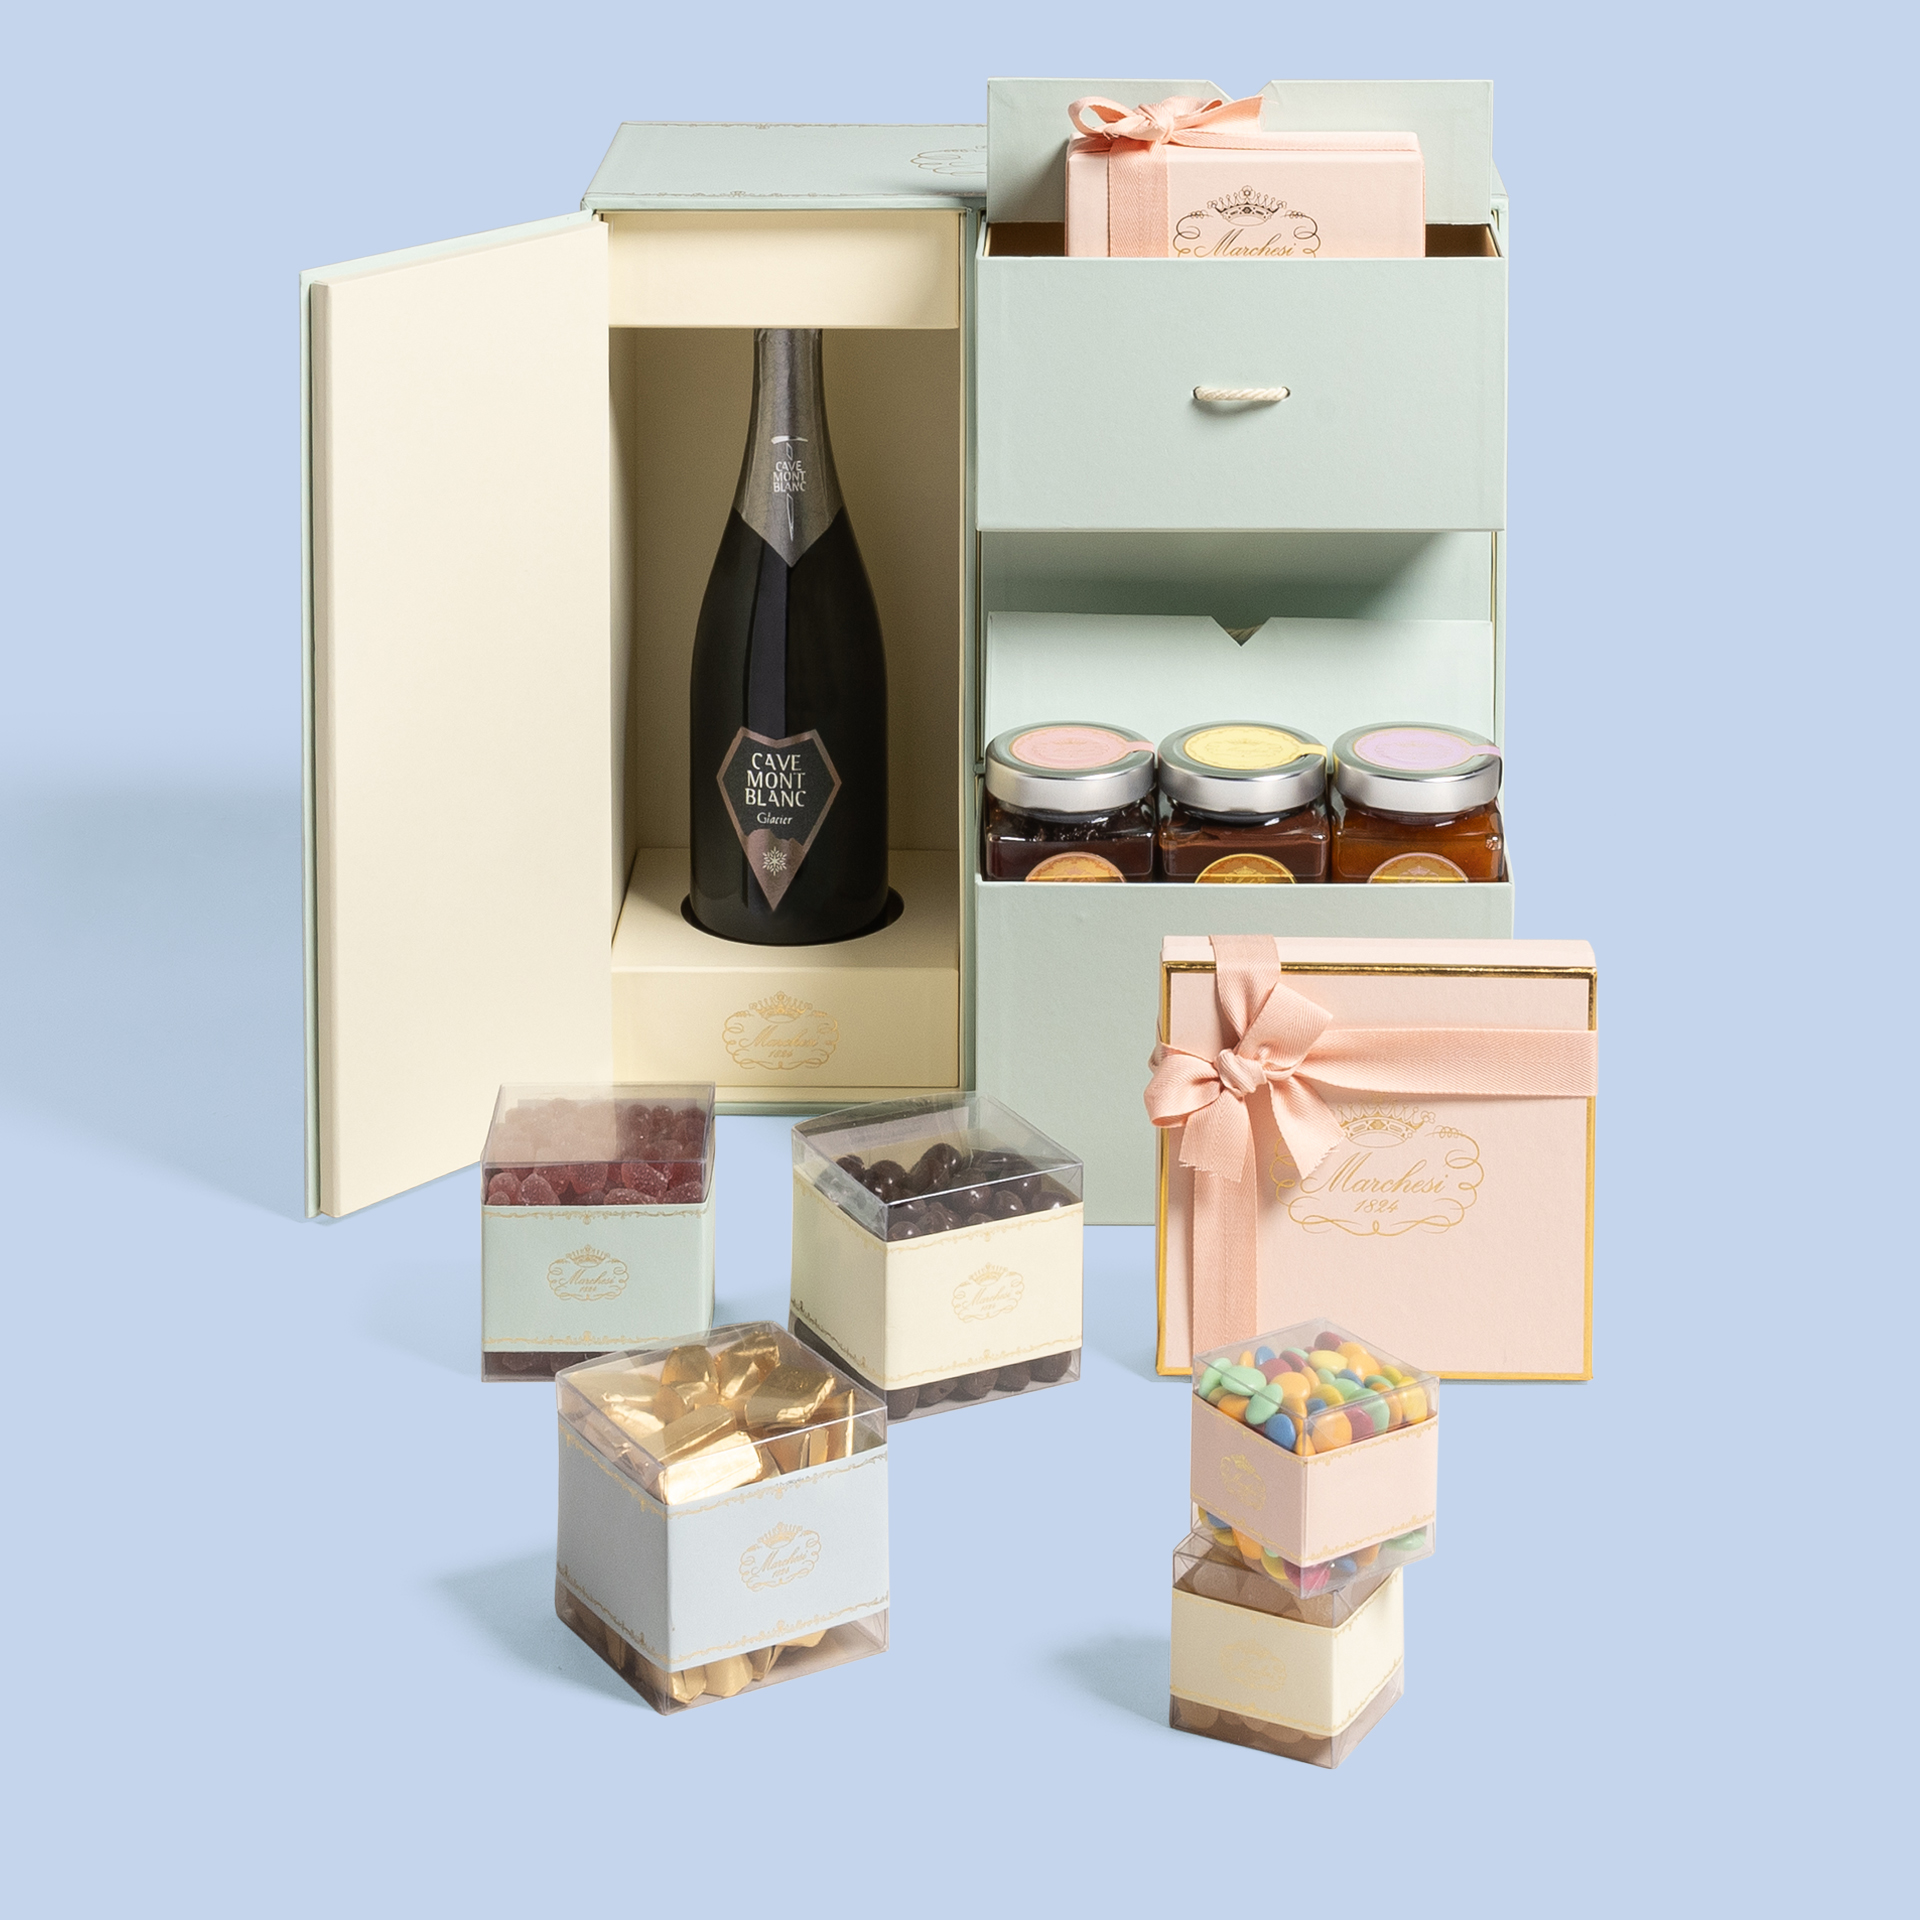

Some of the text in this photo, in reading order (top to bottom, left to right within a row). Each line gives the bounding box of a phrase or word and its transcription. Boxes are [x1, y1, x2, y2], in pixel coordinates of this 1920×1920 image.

[1194, 228, 1297, 257] Marchesi
[775, 460, 802, 472] CAVE
[772, 471, 806, 482] MONT
[772, 481, 807, 493] BLANC
[751, 752, 802, 771] CAVE
[746, 770, 806, 789] MONT
[744, 787, 807, 808] BLANC
[756, 811, 793, 825] Glacier
[738, 1024, 819, 1048] Marchesi
[1299, 1151, 1449, 1194] Marchesi
[1353, 1199, 1400, 1214] 1824
